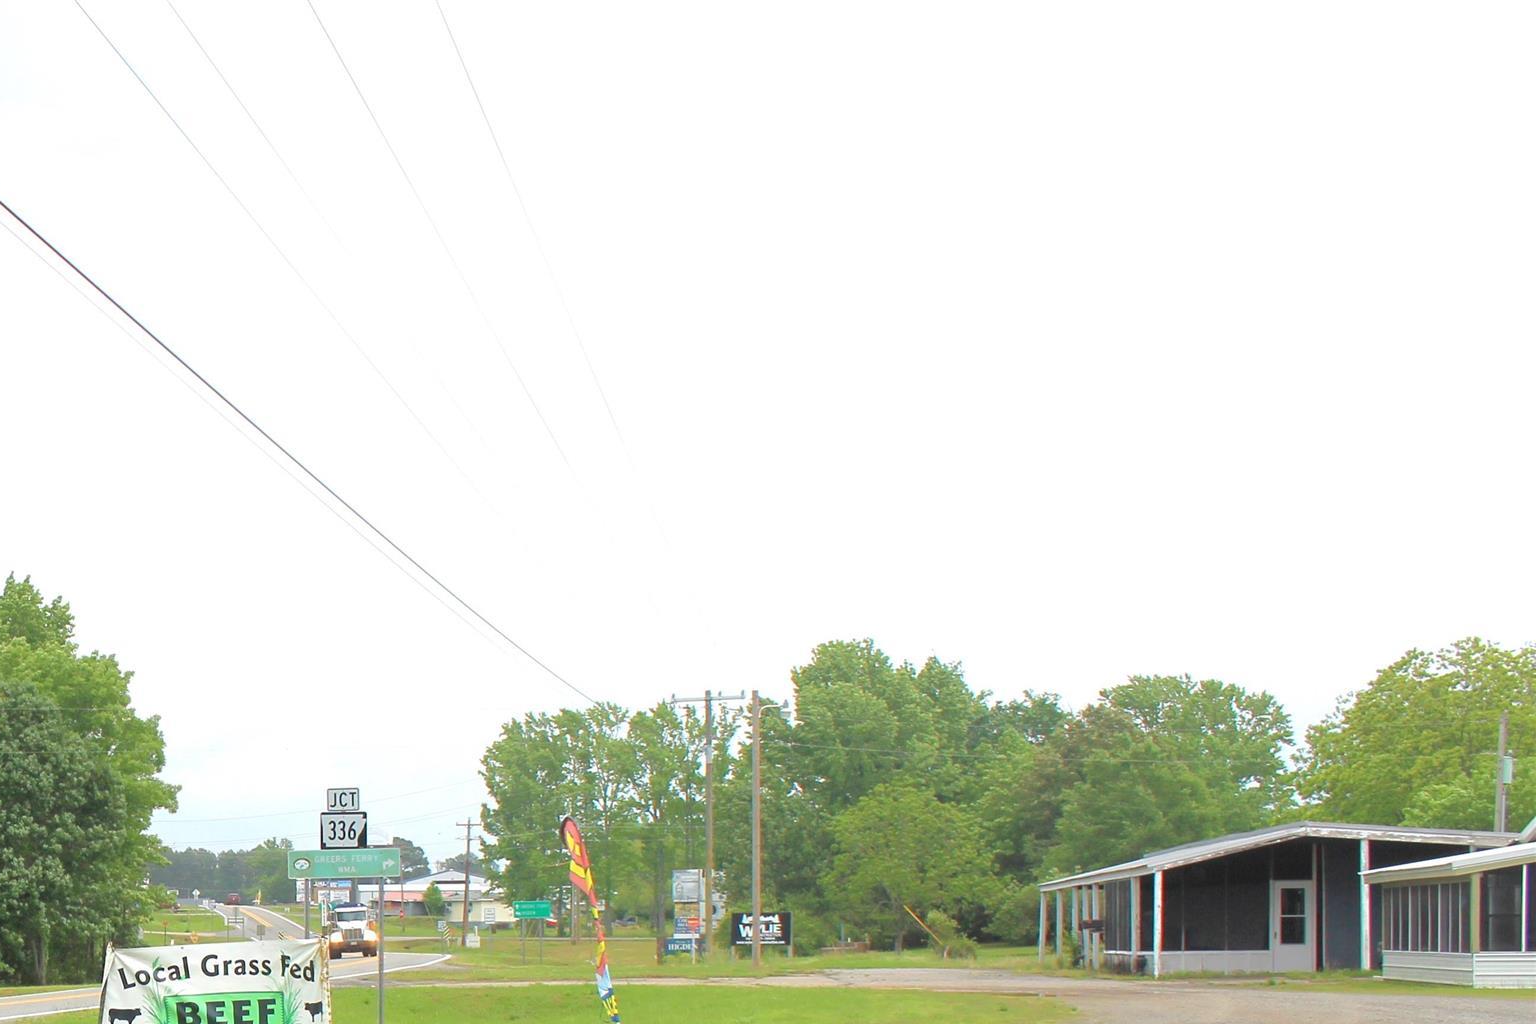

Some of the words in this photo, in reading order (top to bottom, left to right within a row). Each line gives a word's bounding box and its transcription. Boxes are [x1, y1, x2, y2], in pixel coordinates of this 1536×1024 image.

[329, 791, 357, 808] JCT
[328, 820, 357, 841] 336
[314, 855, 346, 864] GREERS
[351, 854, 378, 864] FERRY
[117, 955, 191, 990] Local
[201, 954, 272, 977] Grass
[280, 954, 316, 982] Fed
